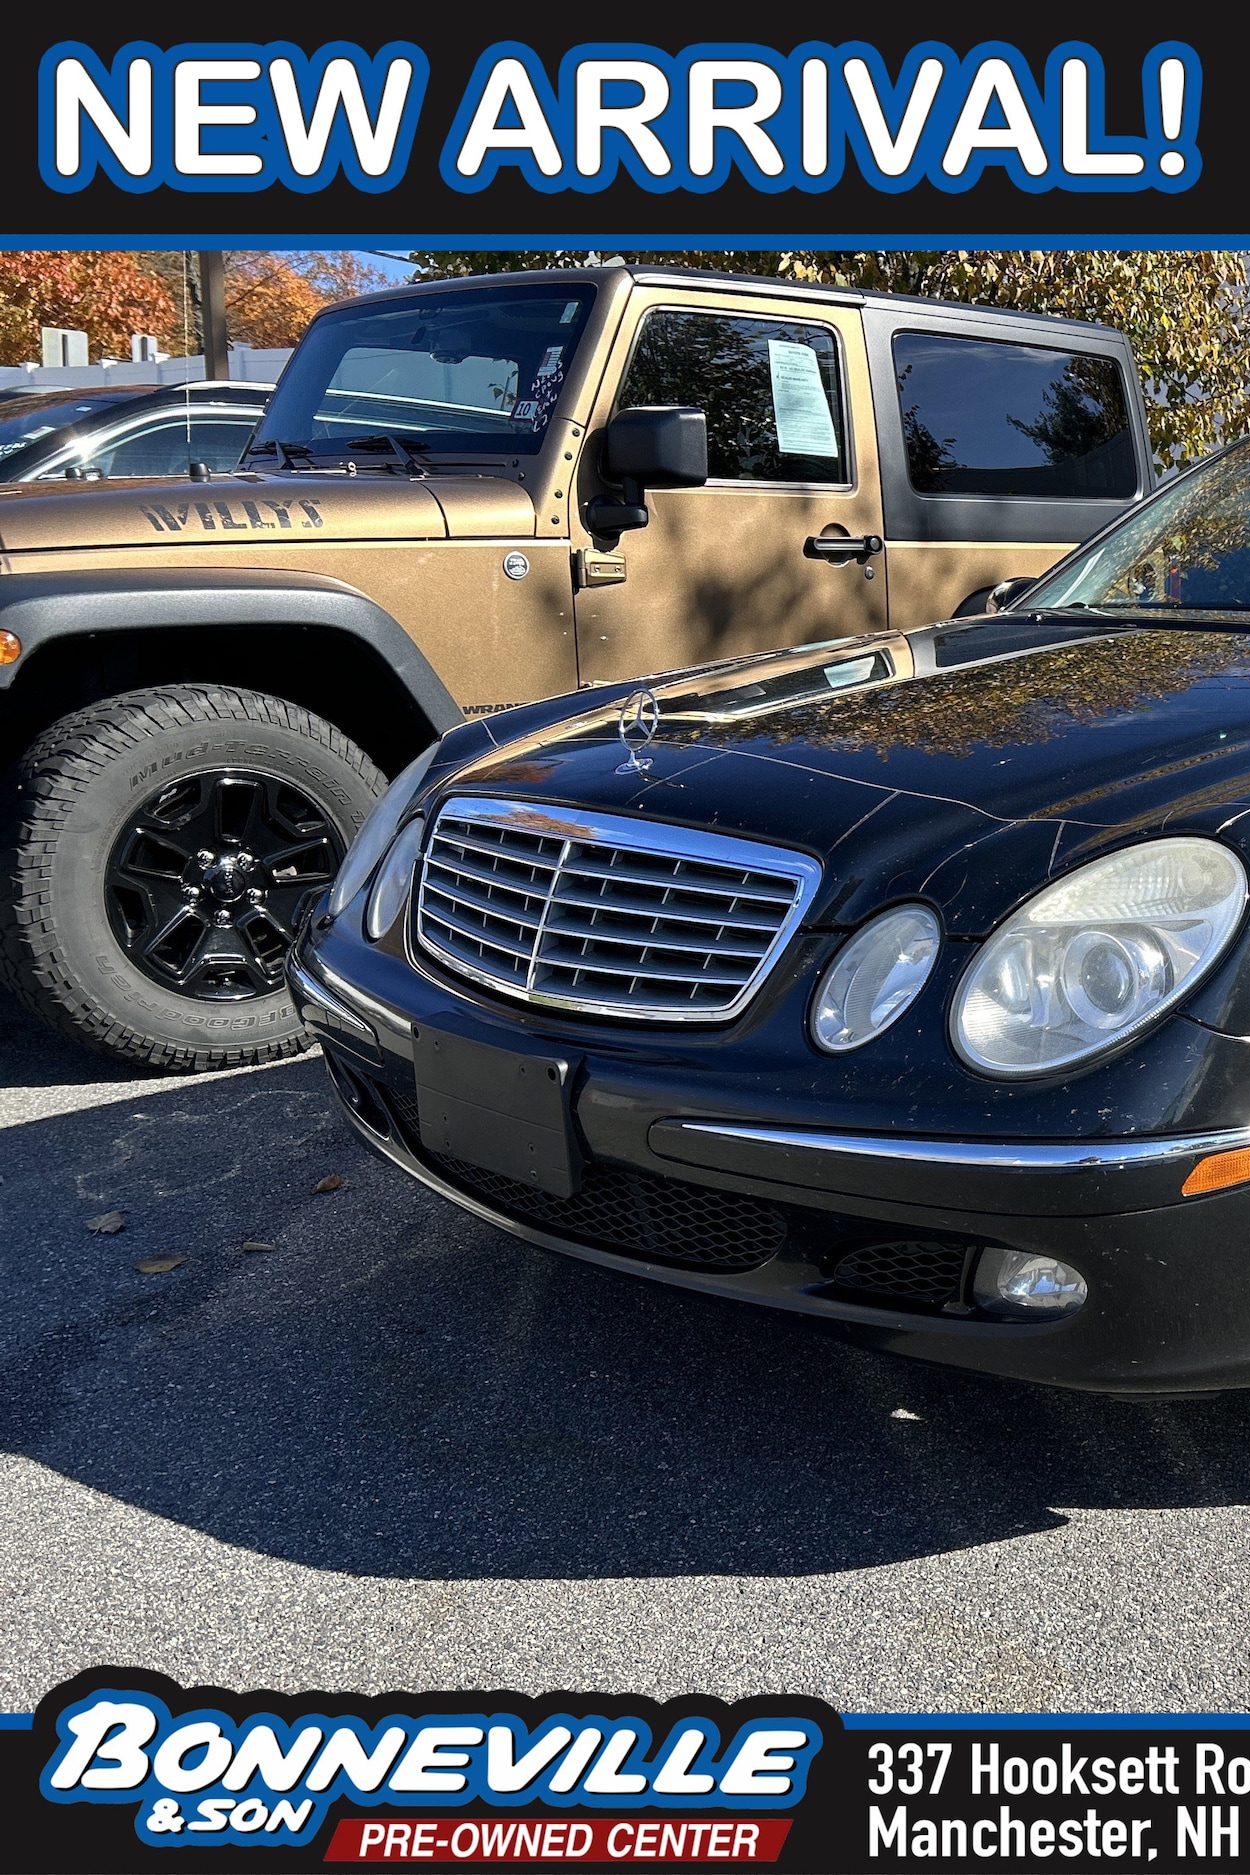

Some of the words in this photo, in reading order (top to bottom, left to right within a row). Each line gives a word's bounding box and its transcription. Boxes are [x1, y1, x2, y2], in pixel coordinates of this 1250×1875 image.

[515, 402, 532, 417] 10
[138, 500, 324, 531] WILLYS
[462, 702, 530, 714] WRAN
